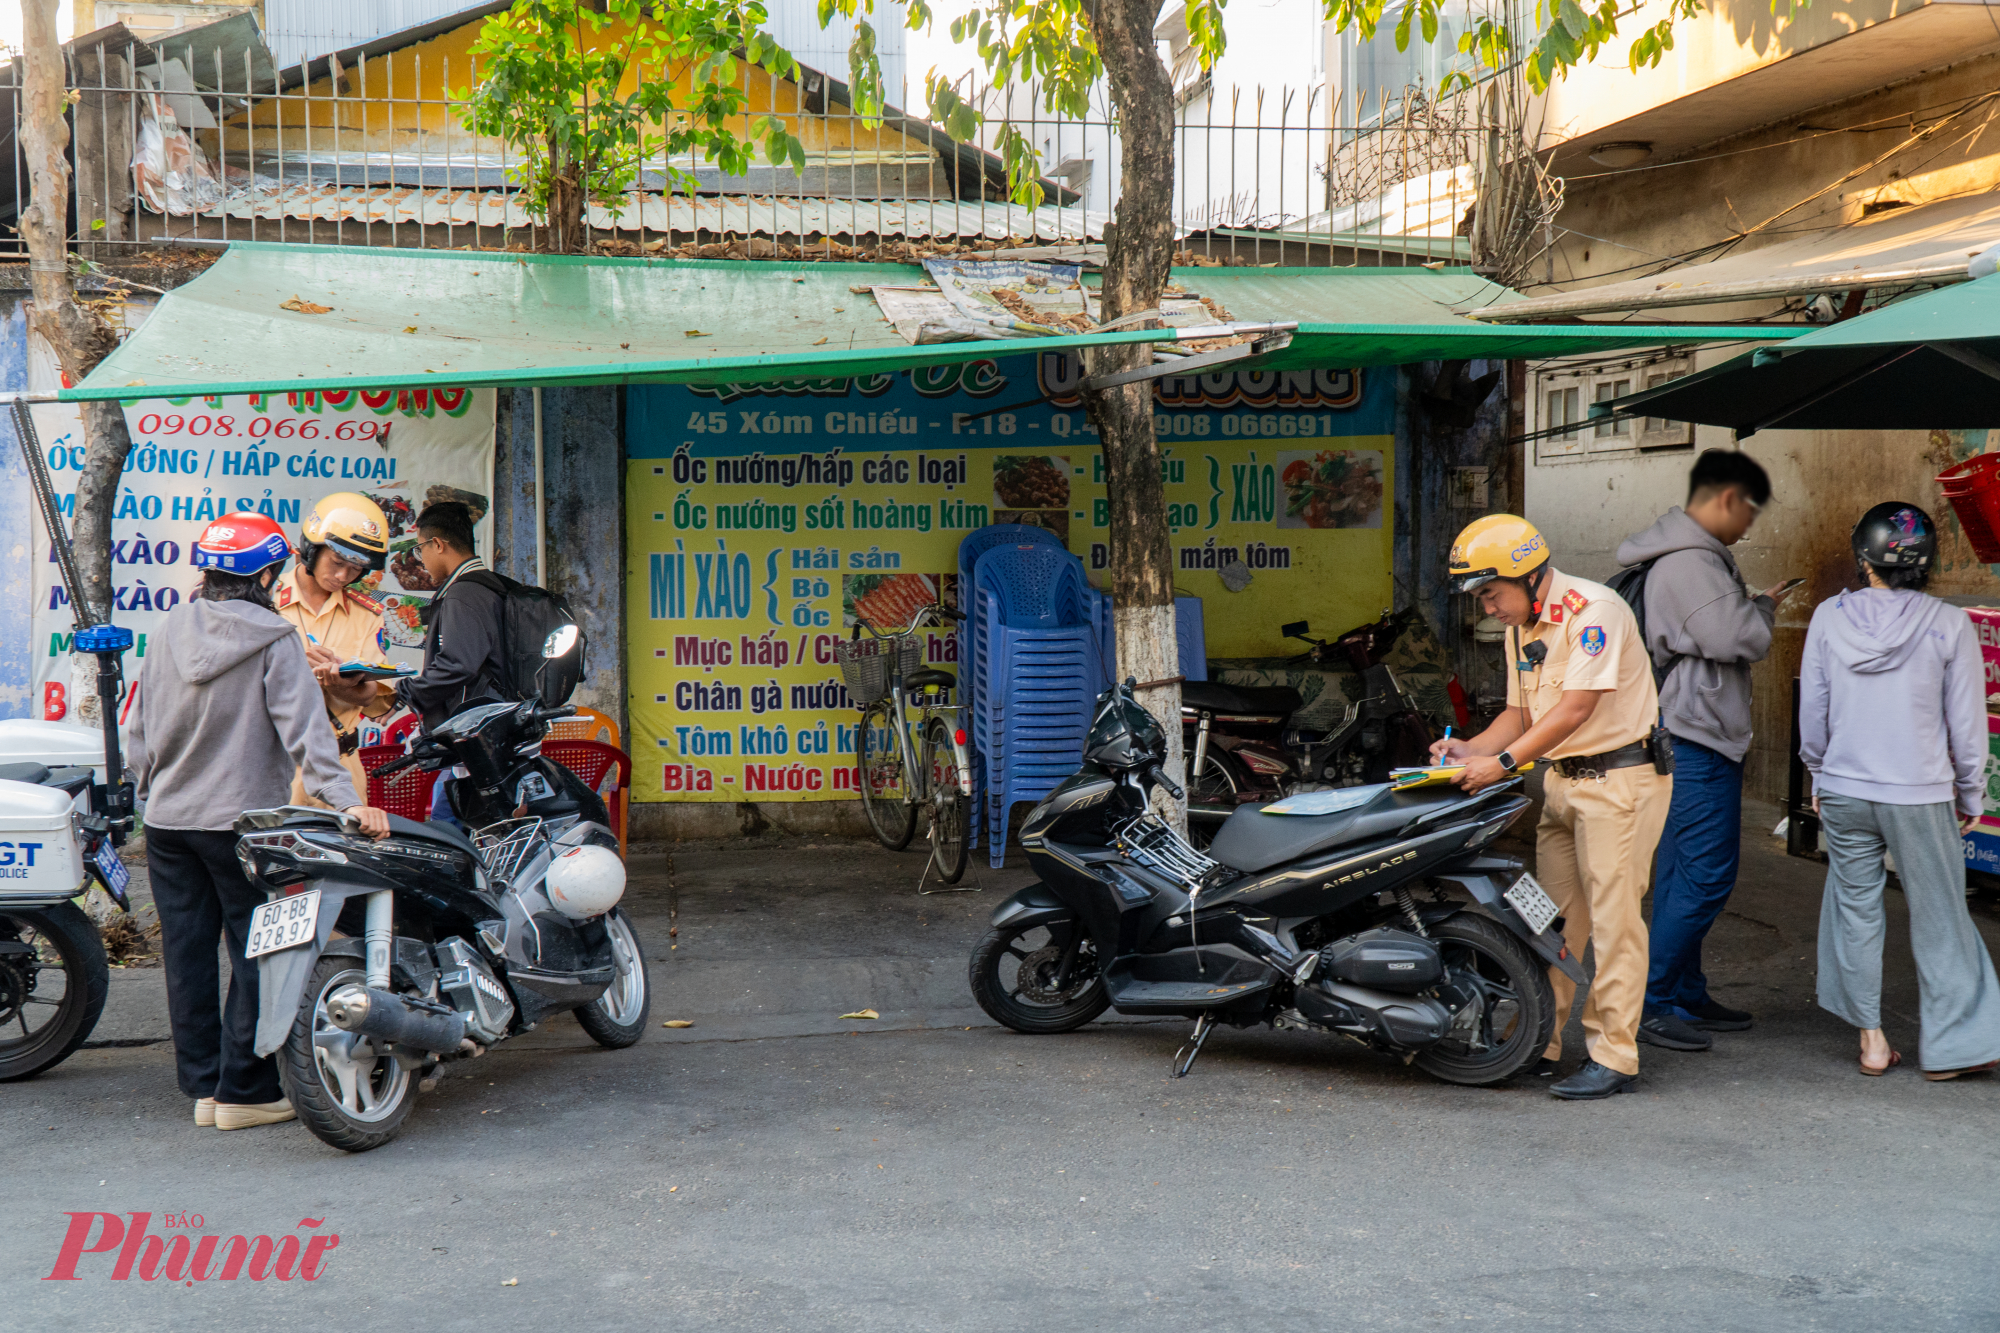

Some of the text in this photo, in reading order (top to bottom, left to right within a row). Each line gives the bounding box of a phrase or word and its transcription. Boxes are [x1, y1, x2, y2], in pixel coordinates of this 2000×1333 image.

[138, 413, 393, 442] 0908.066.691
[687, 411, 728, 435] 45
[738, 410, 813, 435] Xóm
[824, 408, 918, 435] Chiếu
[952, 412, 1017, 436] P.18
[1154, 413, 1211, 436] 908
[1221, 413, 1332, 436] 066691
[48, 433, 86, 471] ỐC
[222, 439, 281, 477] HẤP
[286, 448, 335, 479] CÁC
[341, 454, 397, 485] LOẠI
[672, 442, 707, 485] Ốc
[715, 446, 854, 488] nướng/hấp
[862, 452, 909, 485] các
[918, 454, 967, 490] loại
[112, 486, 163, 520] ÀO
[171, 486, 227, 522] HẢI
[1231, 451, 1275, 523] XÀO
[672, 489, 707, 530] Ốc
[715, 495, 797, 533] nướng
[805, 494, 845, 530] sốt
[853, 495, 932, 533] hoàng
[940, 502, 989, 530] kim
[1168, 502, 1199, 533] ạo
[791, 546, 901, 569] Hải sản
[1180, 537, 1291, 569] mắm tôm
[650, 539, 751, 620] MÌ XÀO
[791, 576, 830, 599] Bò
[791, 599, 830, 628] Ốc
[674, 634, 733, 673] Mực
[741, 629, 790, 669] hấp
[675, 680, 742, 712] Chân
[750, 680, 786, 714] gà
[675, 725, 732, 756] Tôm
[740, 723, 788, 756] khô
[797, 720, 829, 756] củ
[663, 763, 714, 793] Bia
[745, 763, 823, 793] Nước
[1321, 850, 1418, 891] AIRBLADE
[261, 896, 310, 928] 60-B8
[251, 918, 312, 953] 928.97
